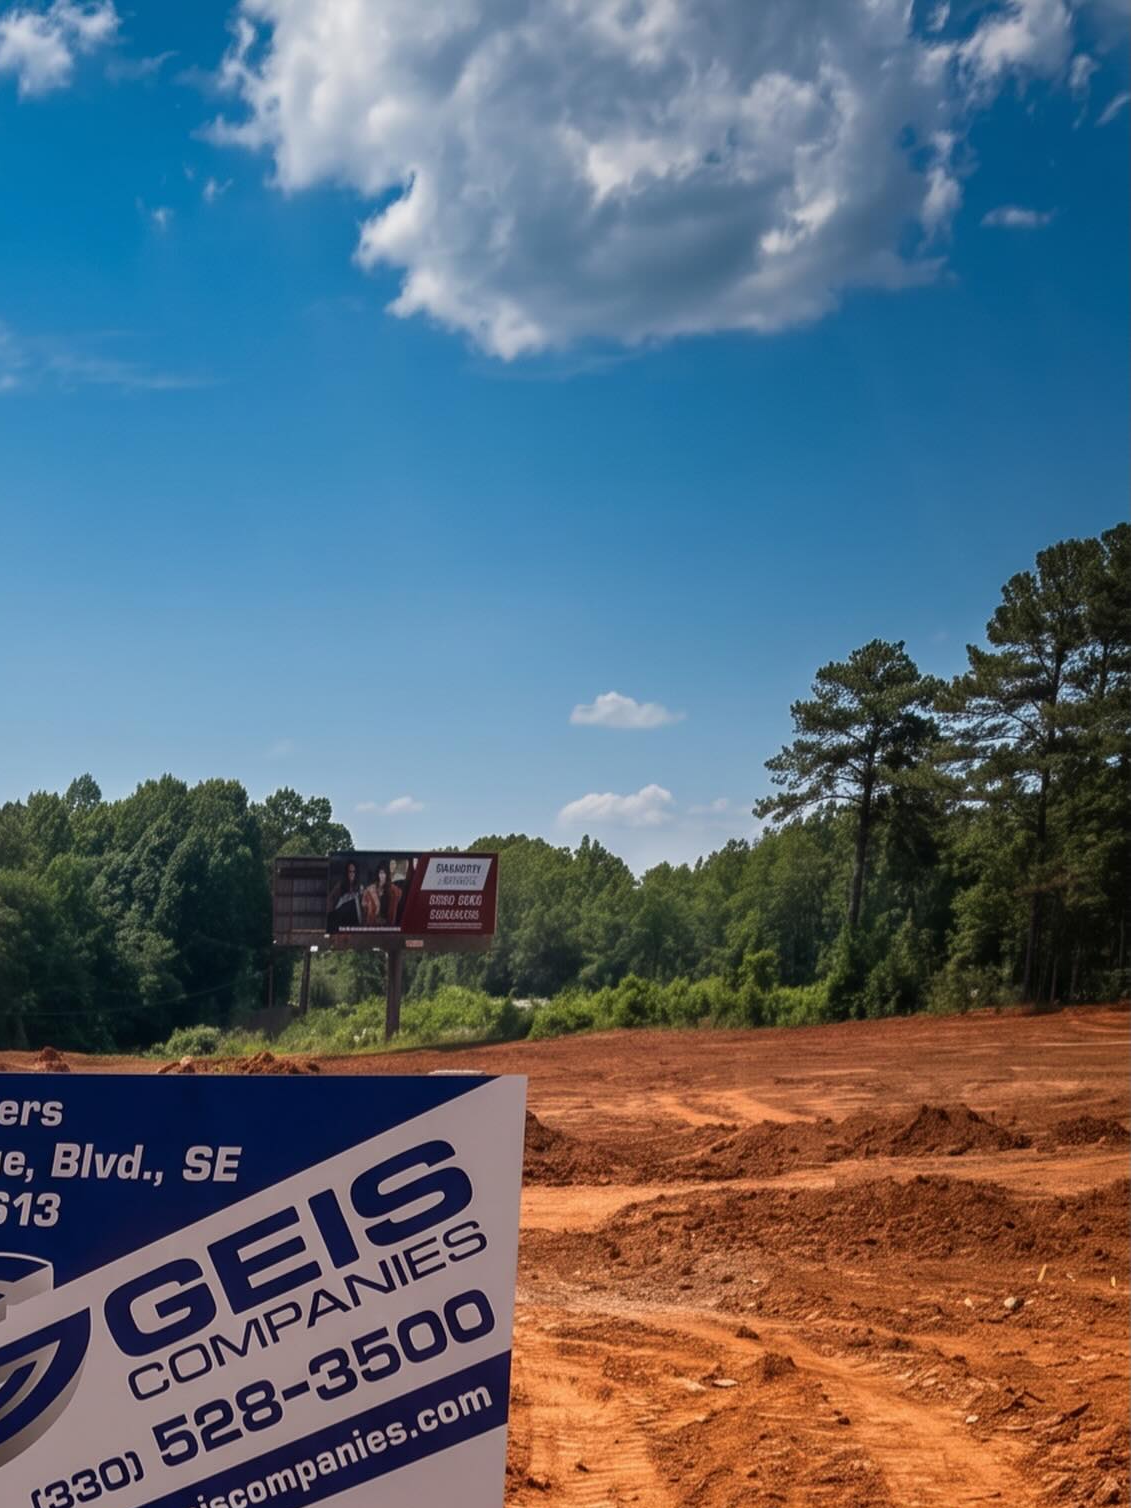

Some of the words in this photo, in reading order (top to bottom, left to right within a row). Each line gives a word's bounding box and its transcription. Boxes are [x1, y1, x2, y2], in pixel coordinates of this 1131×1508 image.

[51, 1143, 164, 1187] Blvd.,
[182, 1145, 243, 1182] SE
[103, 1139, 473, 1357] GEIS
[127, 1220, 488, 1401] COMPANIES
[151, 1289, 496, 1467] 528-3500
